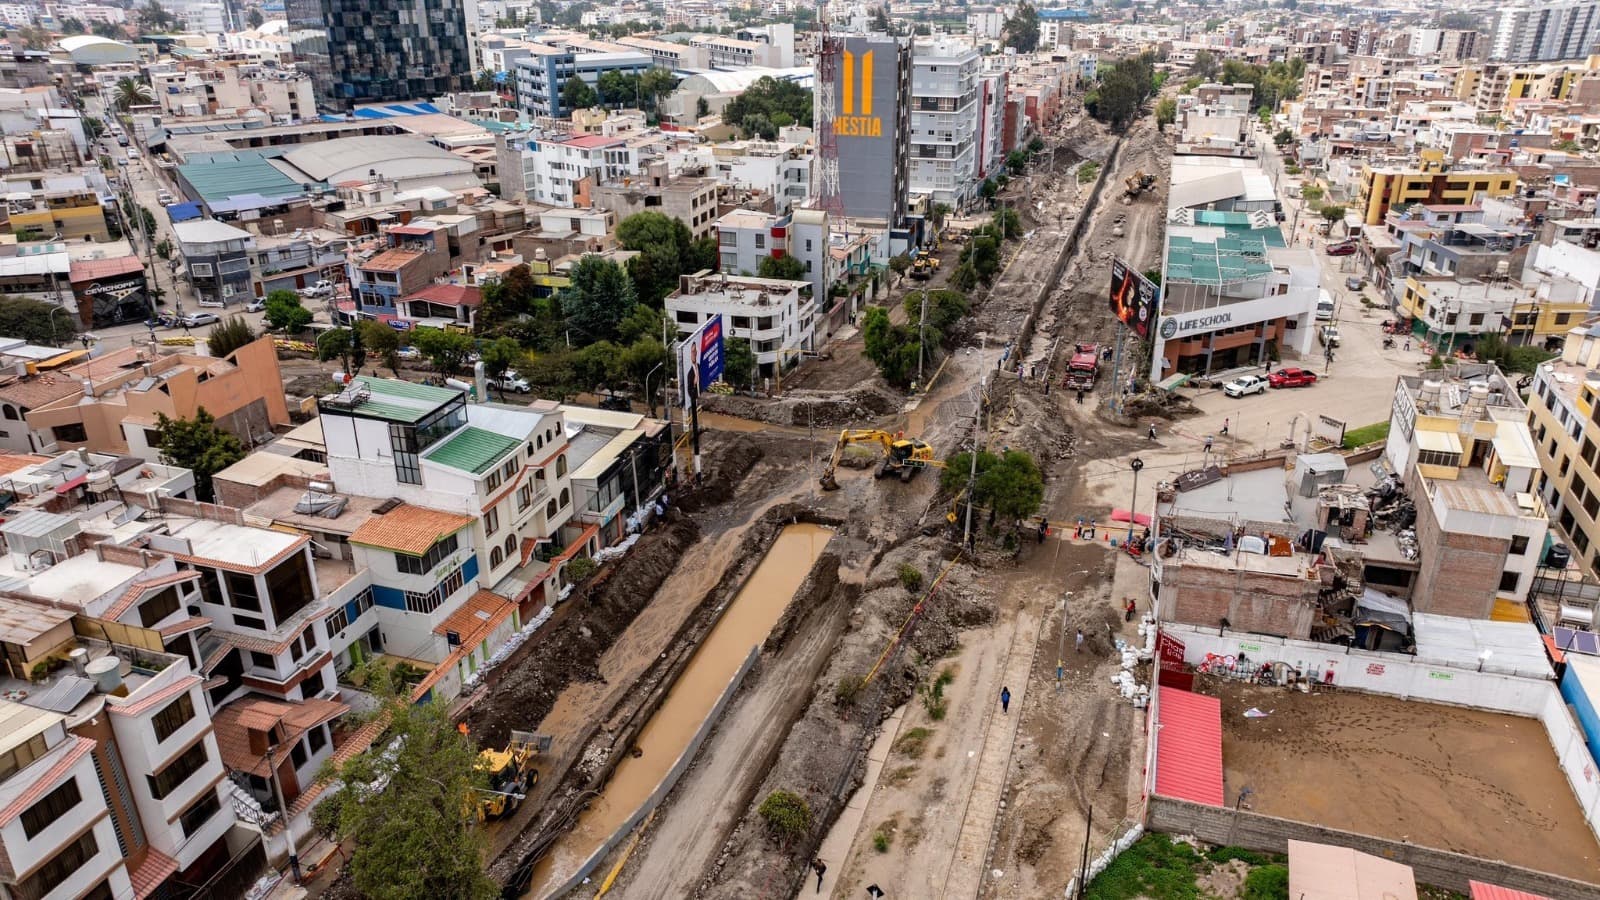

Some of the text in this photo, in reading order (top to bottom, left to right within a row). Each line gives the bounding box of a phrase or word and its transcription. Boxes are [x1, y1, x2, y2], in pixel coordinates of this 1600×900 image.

[832, 116, 882, 137] HESTIA
[1180, 319, 1199, 331] LIFE
[1199, 312, 1232, 328] SCHOOL
